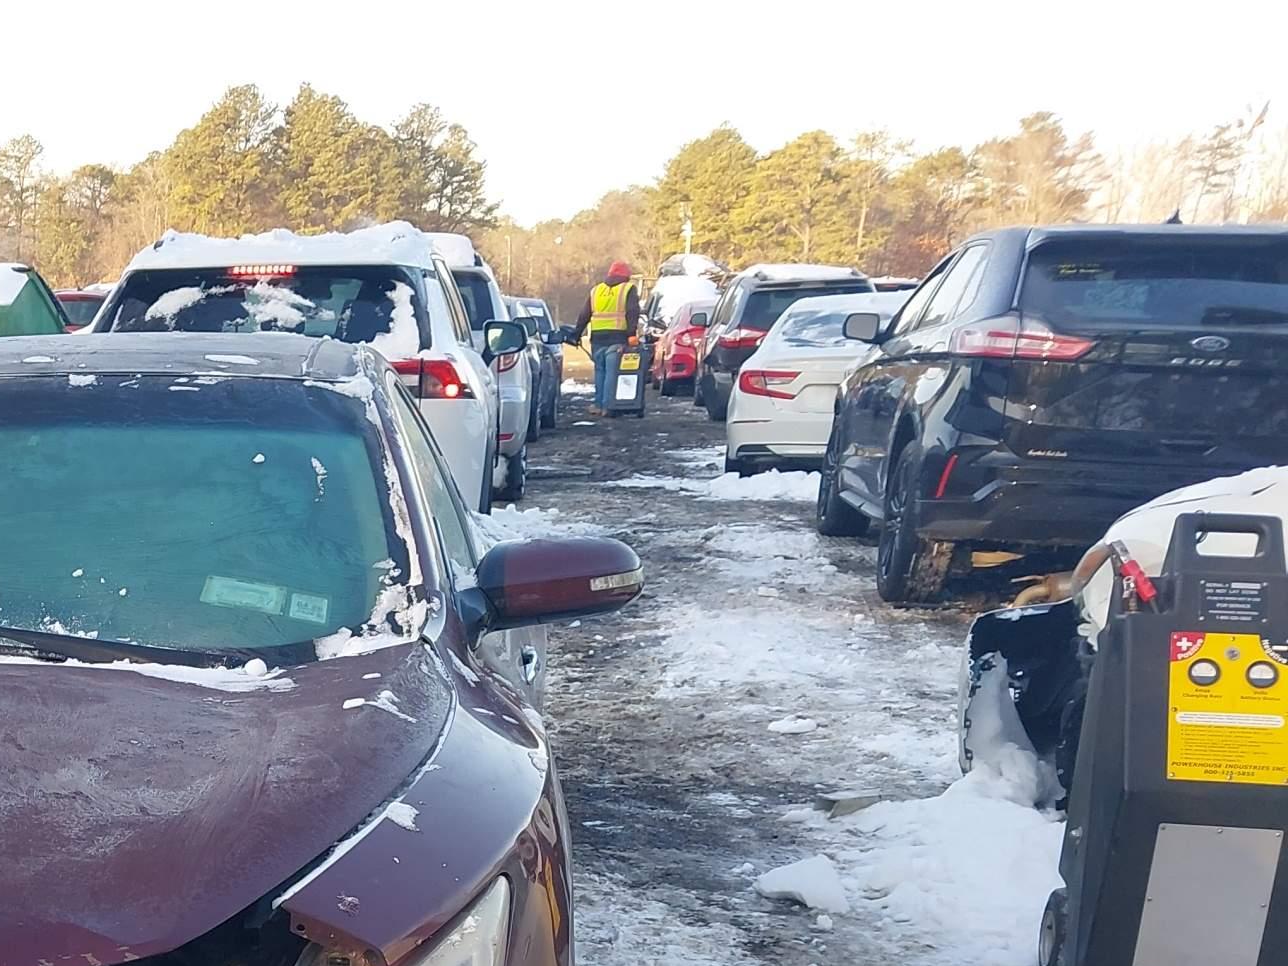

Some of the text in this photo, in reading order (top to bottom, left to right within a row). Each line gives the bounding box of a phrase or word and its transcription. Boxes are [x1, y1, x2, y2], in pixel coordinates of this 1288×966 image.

[1176, 638, 1204, 660] Positive
[1262, 639, 1288, 665] Negative
[1171, 761, 1222, 769] POWERHOUSE
